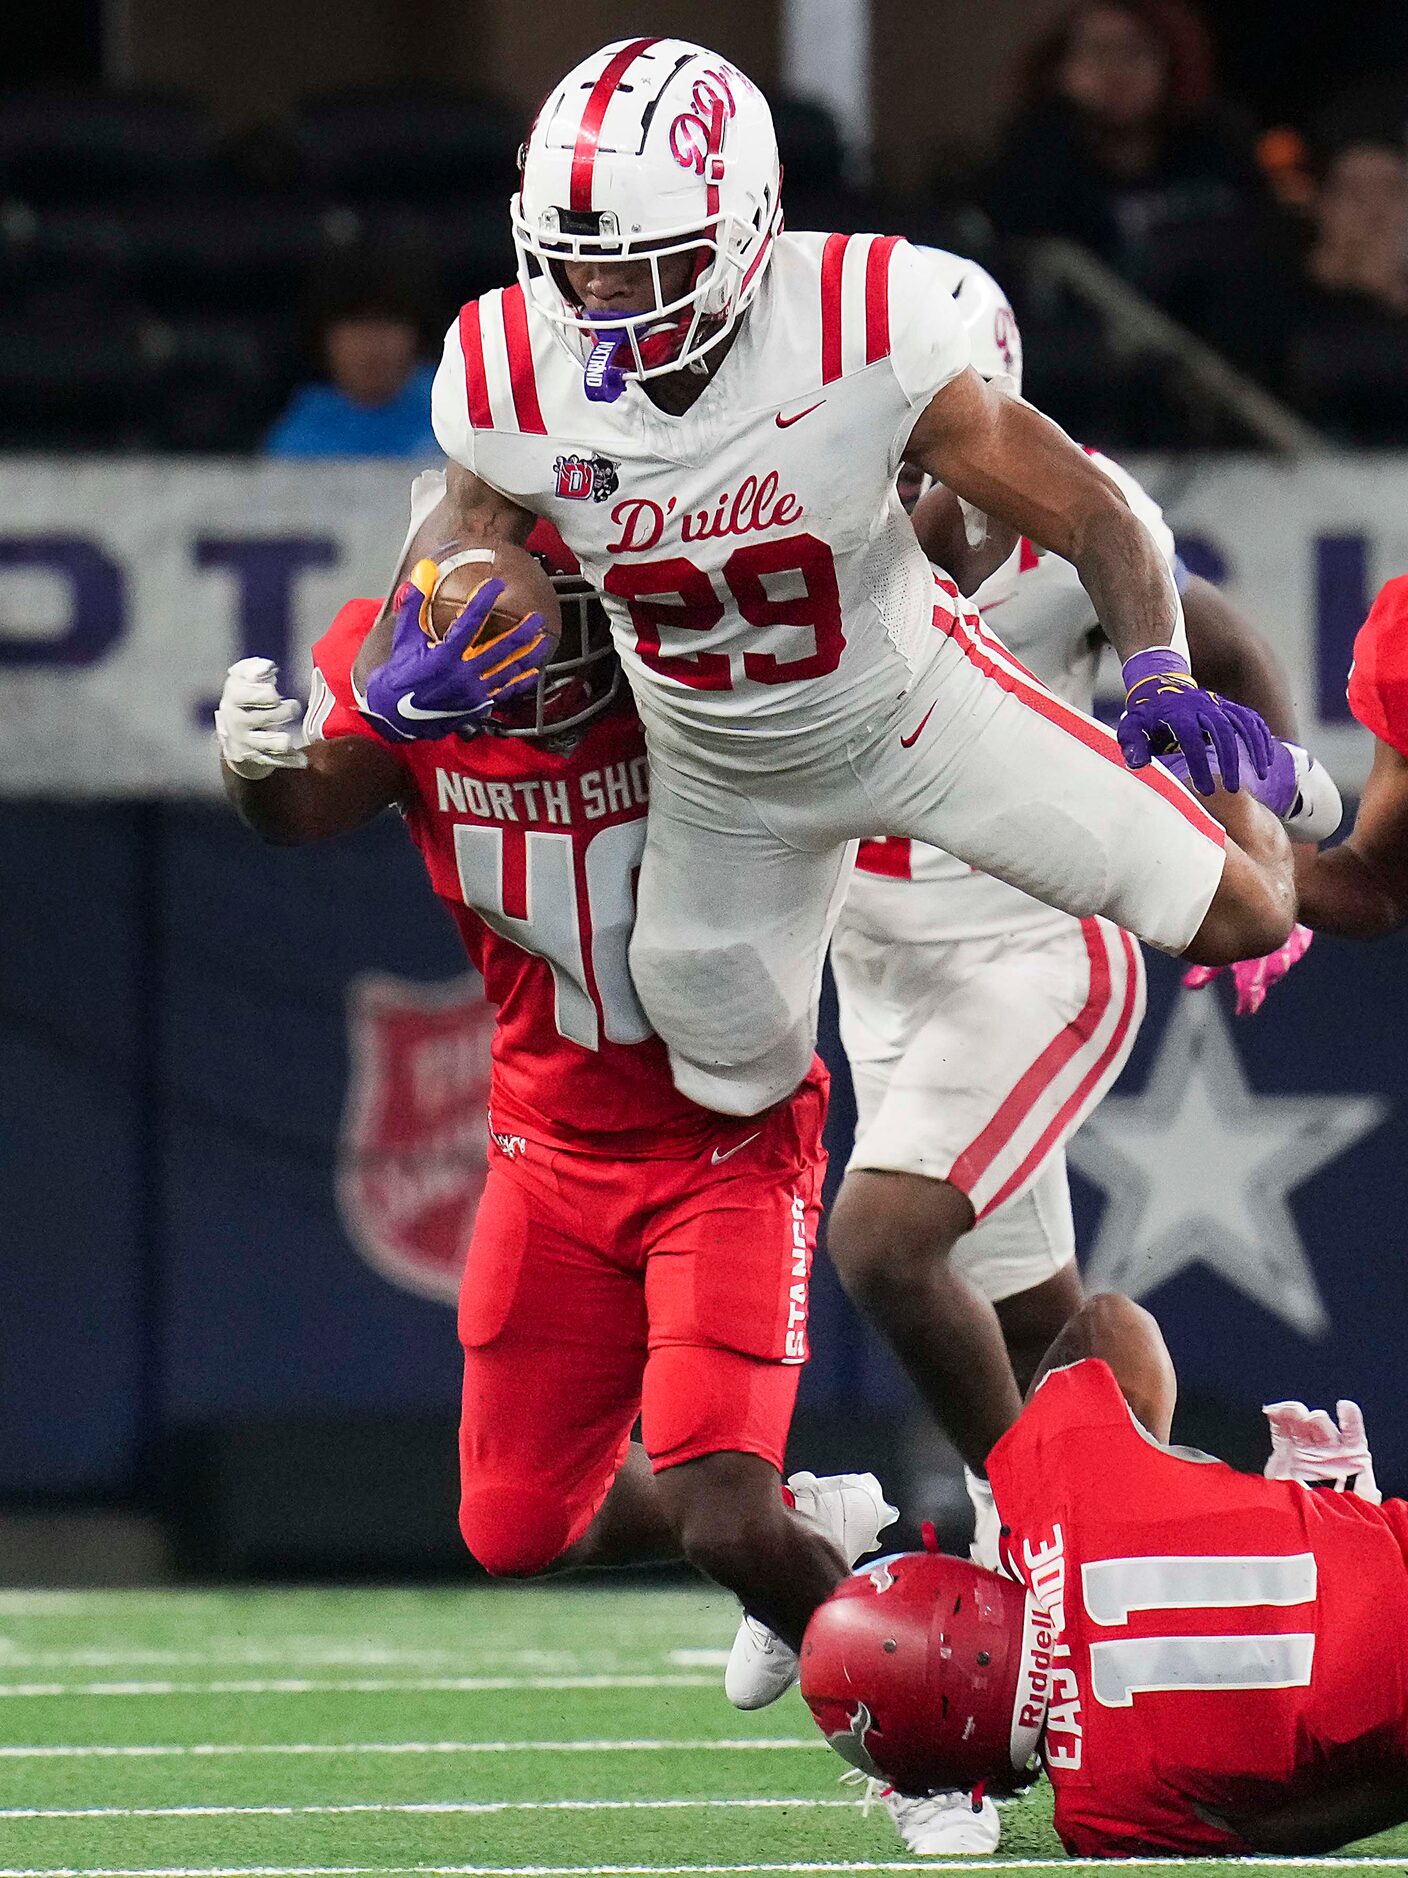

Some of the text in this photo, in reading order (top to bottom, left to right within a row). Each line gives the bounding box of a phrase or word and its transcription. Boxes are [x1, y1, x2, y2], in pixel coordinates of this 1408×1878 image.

[606, 470, 804, 554] D'ville
[603, 532, 848, 692] 29
[434, 756, 650, 825] NORTH SHO
[1018, 1608, 1052, 1730] Riddell
[1080, 1552, 1318, 1708] 11
